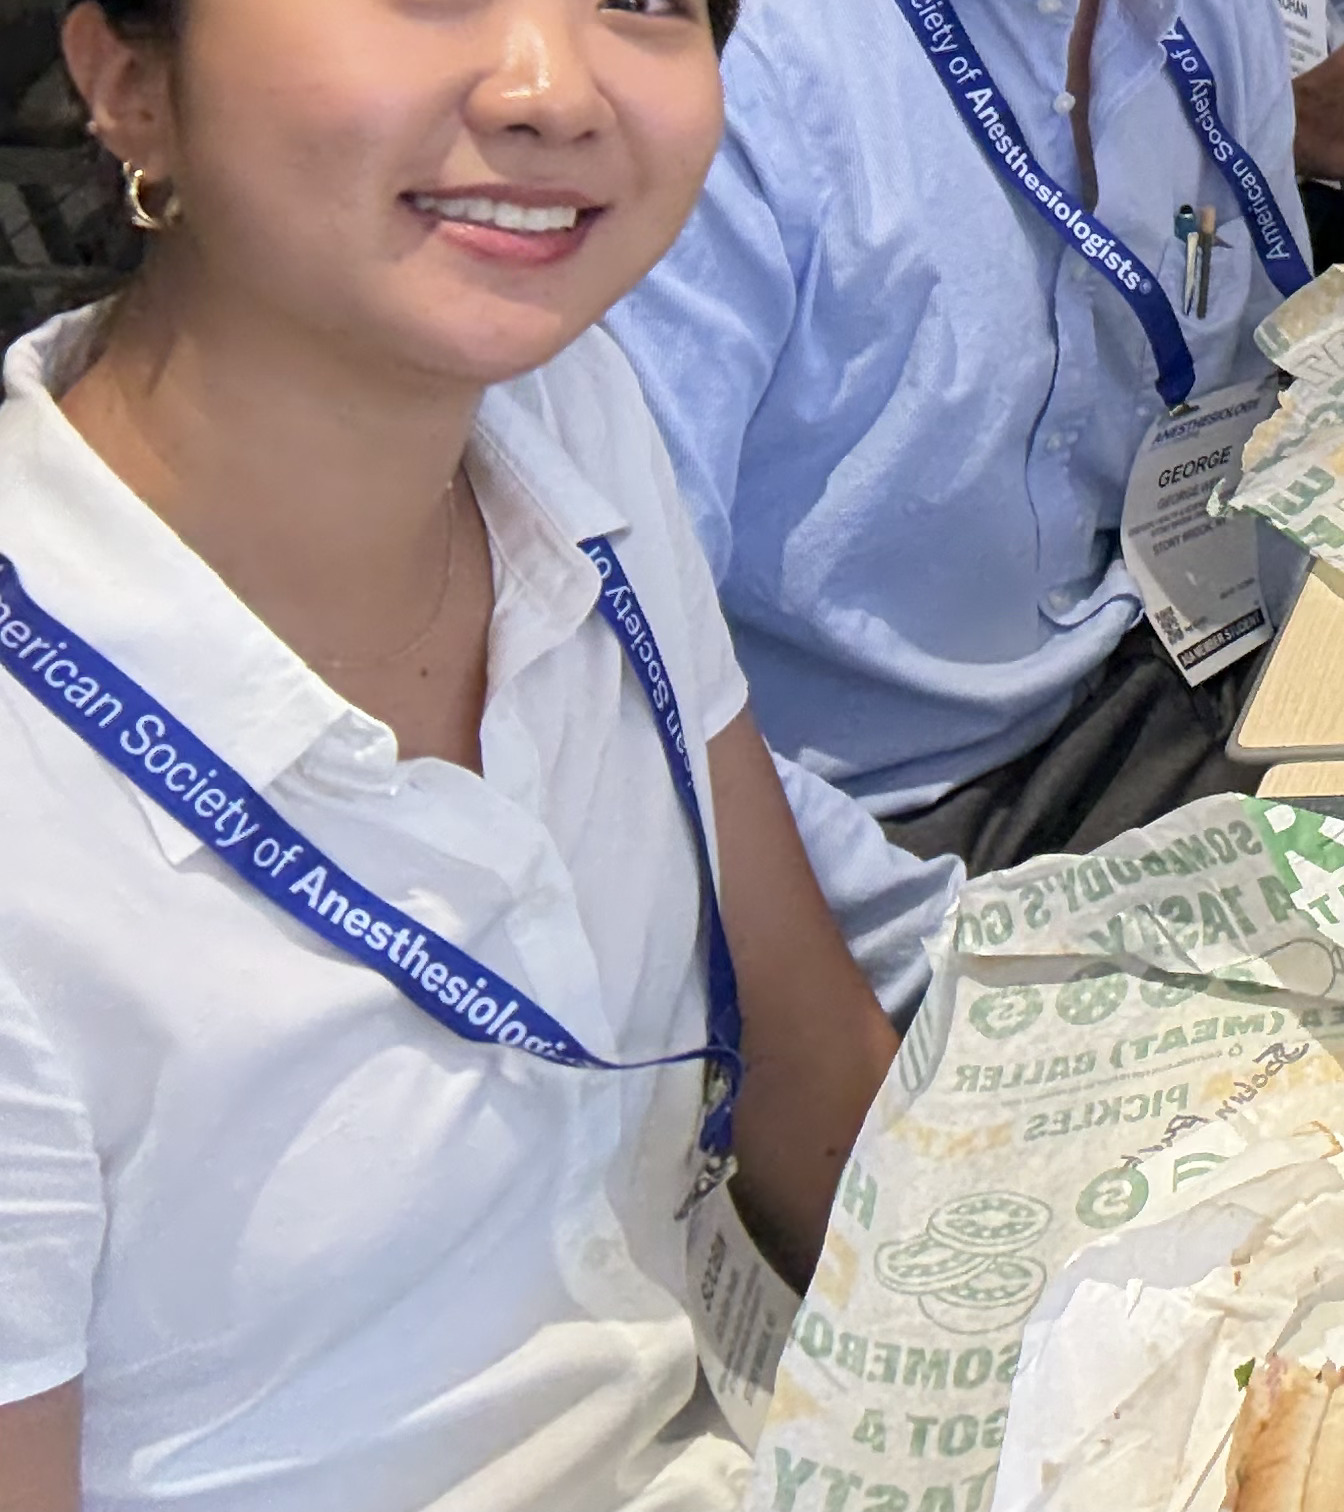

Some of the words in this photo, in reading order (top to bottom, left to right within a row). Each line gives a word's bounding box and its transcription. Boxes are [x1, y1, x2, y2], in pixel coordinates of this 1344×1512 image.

[948, 48, 984, 90] of
[1169, 47, 1202, 76] of
[1189, 73, 1236, 164] Society
[1231, 161, 1290, 265] American
[1158, 445, 1233, 488] GEORGE
[608, 584, 669, 714] Society
[119, 713, 259, 849] Society
[252, 833, 305, 878] of
